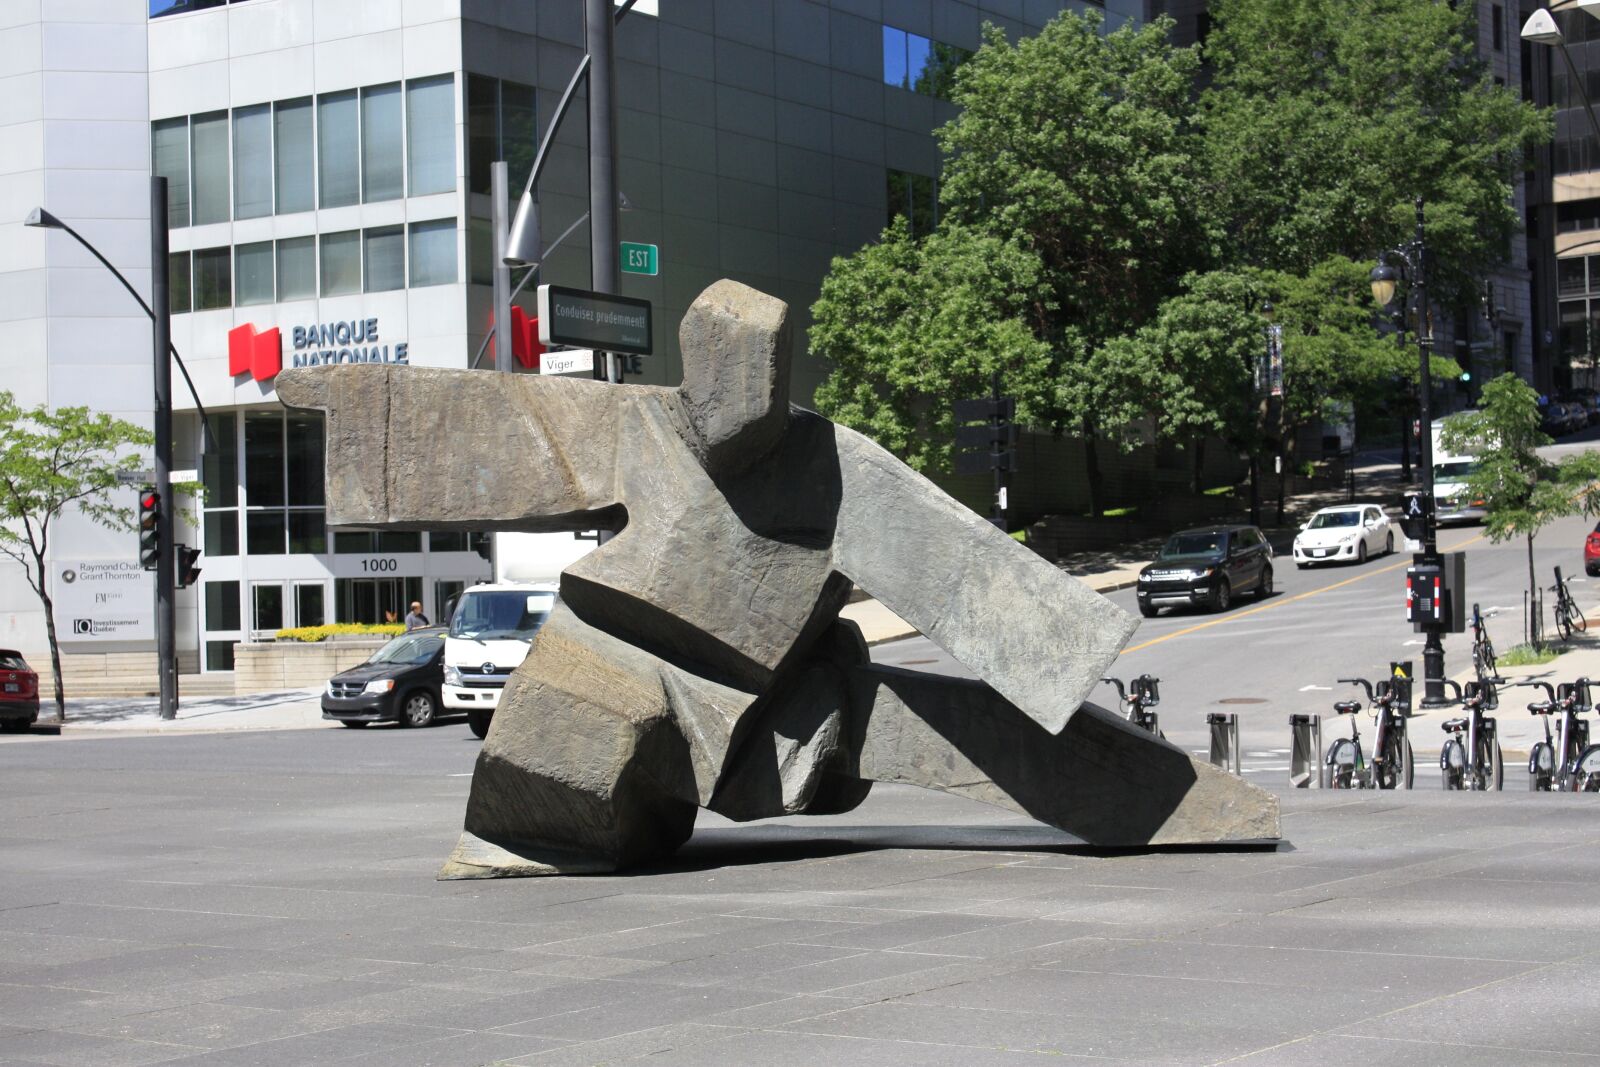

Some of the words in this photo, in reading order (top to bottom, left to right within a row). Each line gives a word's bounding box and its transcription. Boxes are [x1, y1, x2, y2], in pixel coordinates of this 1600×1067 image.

[629, 249, 648, 267] EST
[555, 304, 594, 321] Conduisez
[596, 313, 645, 328] prudemment!
[293, 318, 378, 349] BANQUE
[293, 343, 408, 367] NATIONALE
[547, 359, 574, 371] Viger
[80, 563, 118, 572] Raymond
[361, 559, 397, 571] 1000
[80, 572, 103, 580] Grant
[104, 572, 140, 580] Thornton
